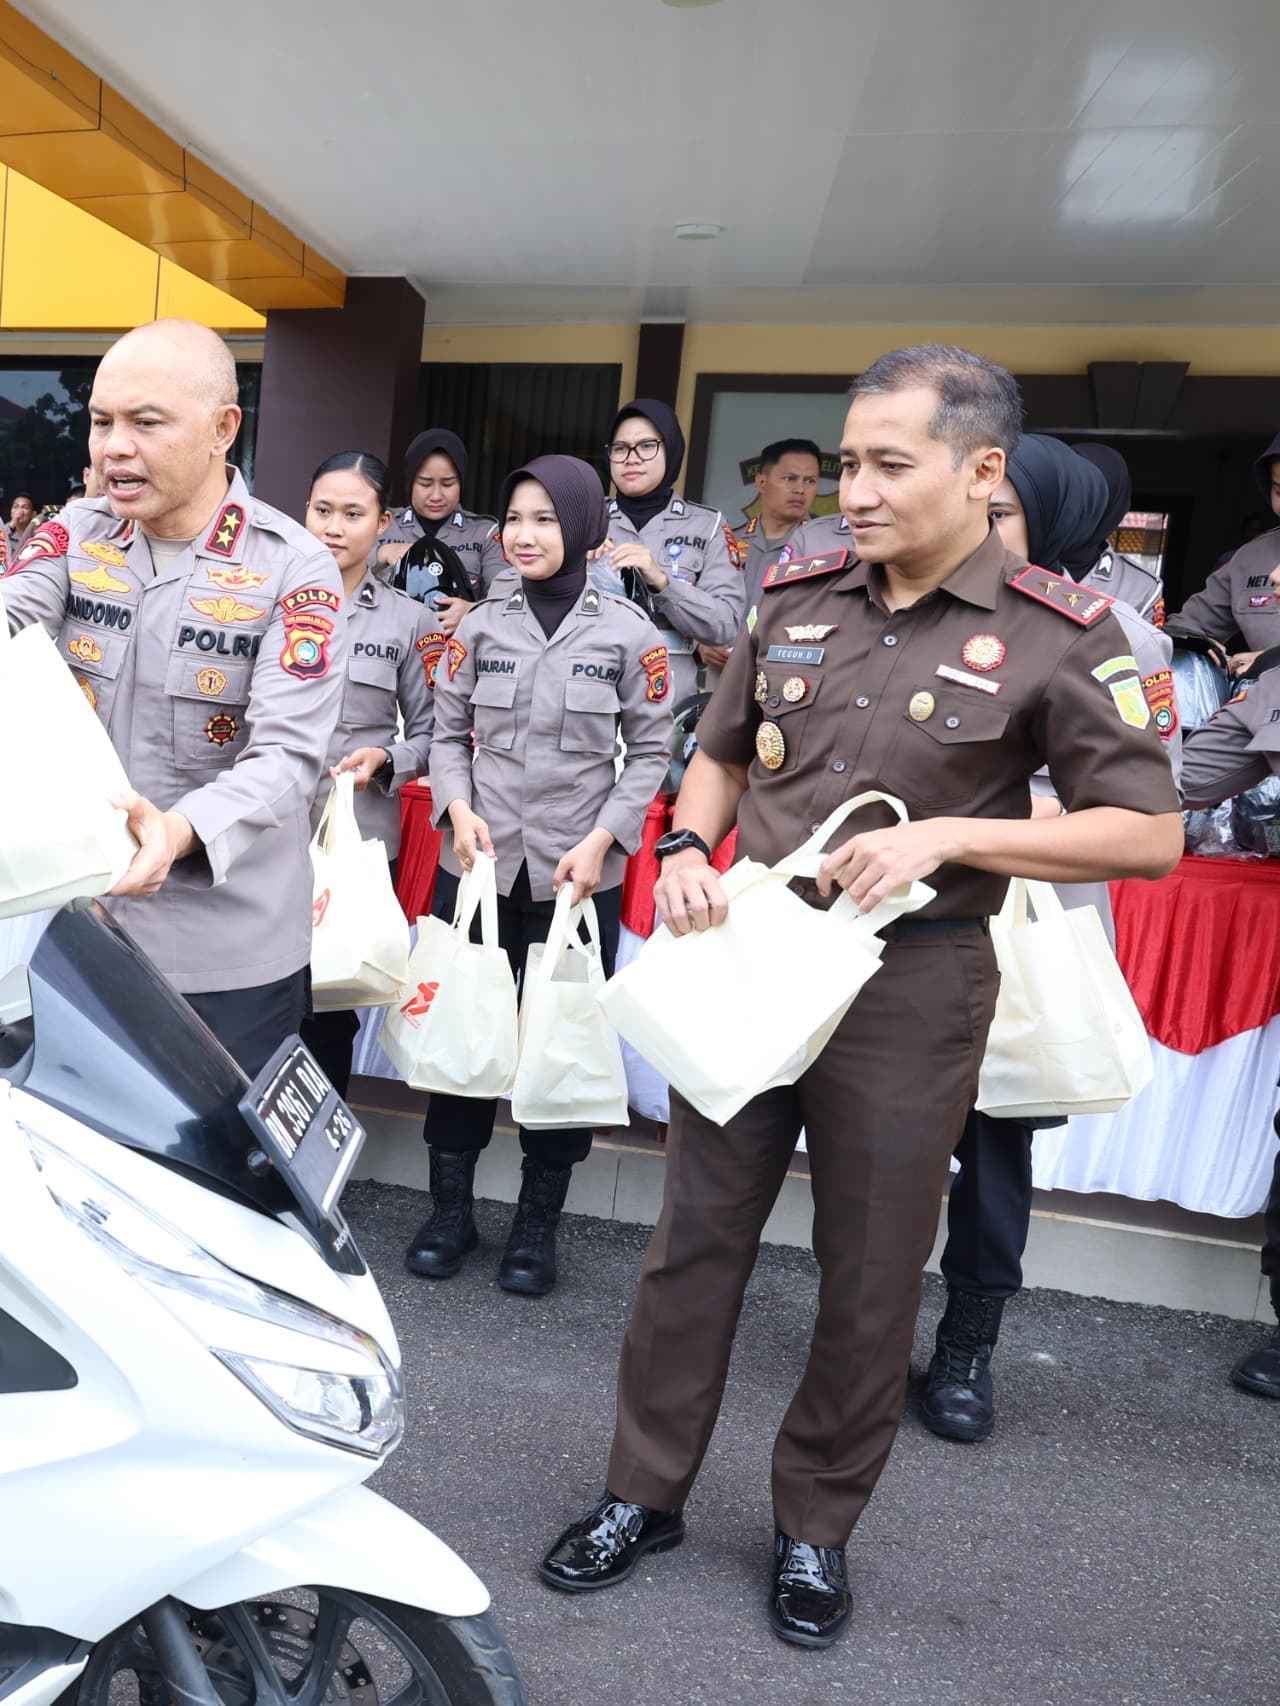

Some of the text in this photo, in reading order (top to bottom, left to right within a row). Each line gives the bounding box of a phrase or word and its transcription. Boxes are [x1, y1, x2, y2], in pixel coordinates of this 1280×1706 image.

[664, 535, 707, 550] POLRI
[287, 590, 337, 608] POLDA
[178, 625, 263, 658] POLRI
[418, 633, 444, 648] POLDA
[353, 642, 400, 662] POLRI
[572, 663, 623, 682] POLRI
[276, 1079, 314, 1137] 3961
